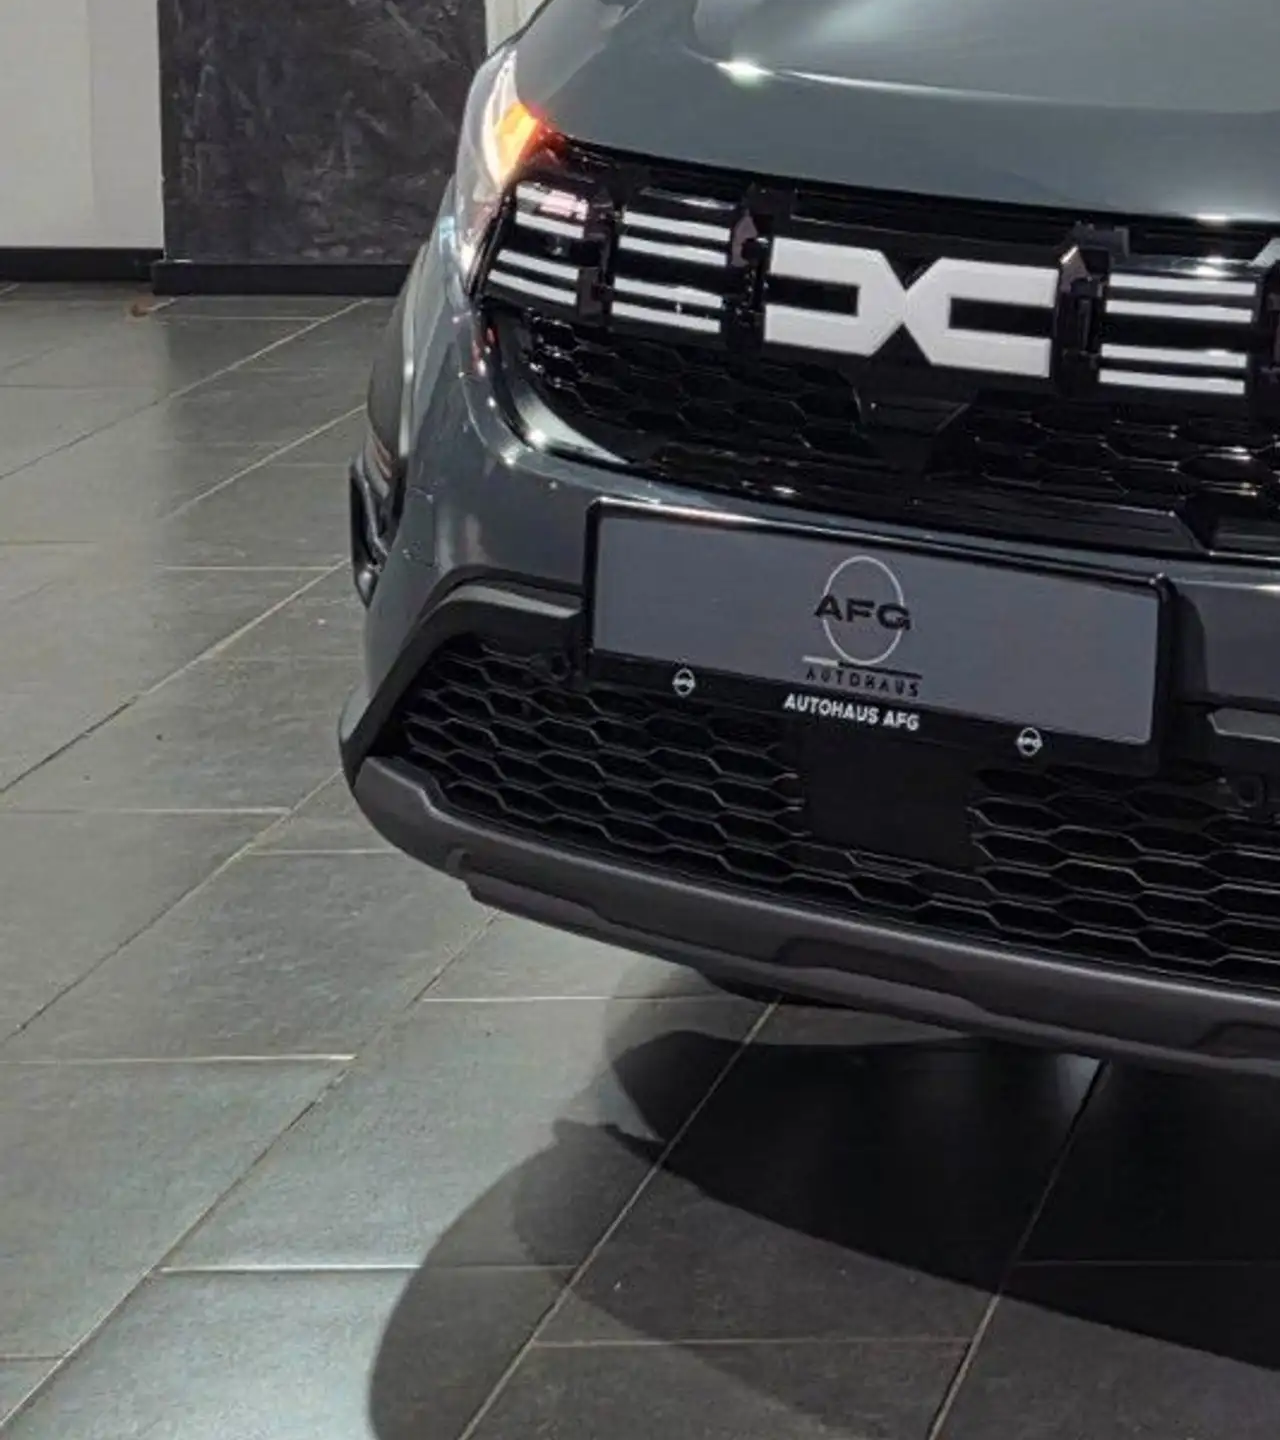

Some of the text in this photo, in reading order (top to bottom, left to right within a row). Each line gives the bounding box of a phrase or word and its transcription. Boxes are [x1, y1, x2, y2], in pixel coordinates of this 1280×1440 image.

[813, 594, 911, 630] AFG
[805, 666, 919, 697] AUTOHAUS
[782, 692, 920, 731] AUTOHAUS AFG
